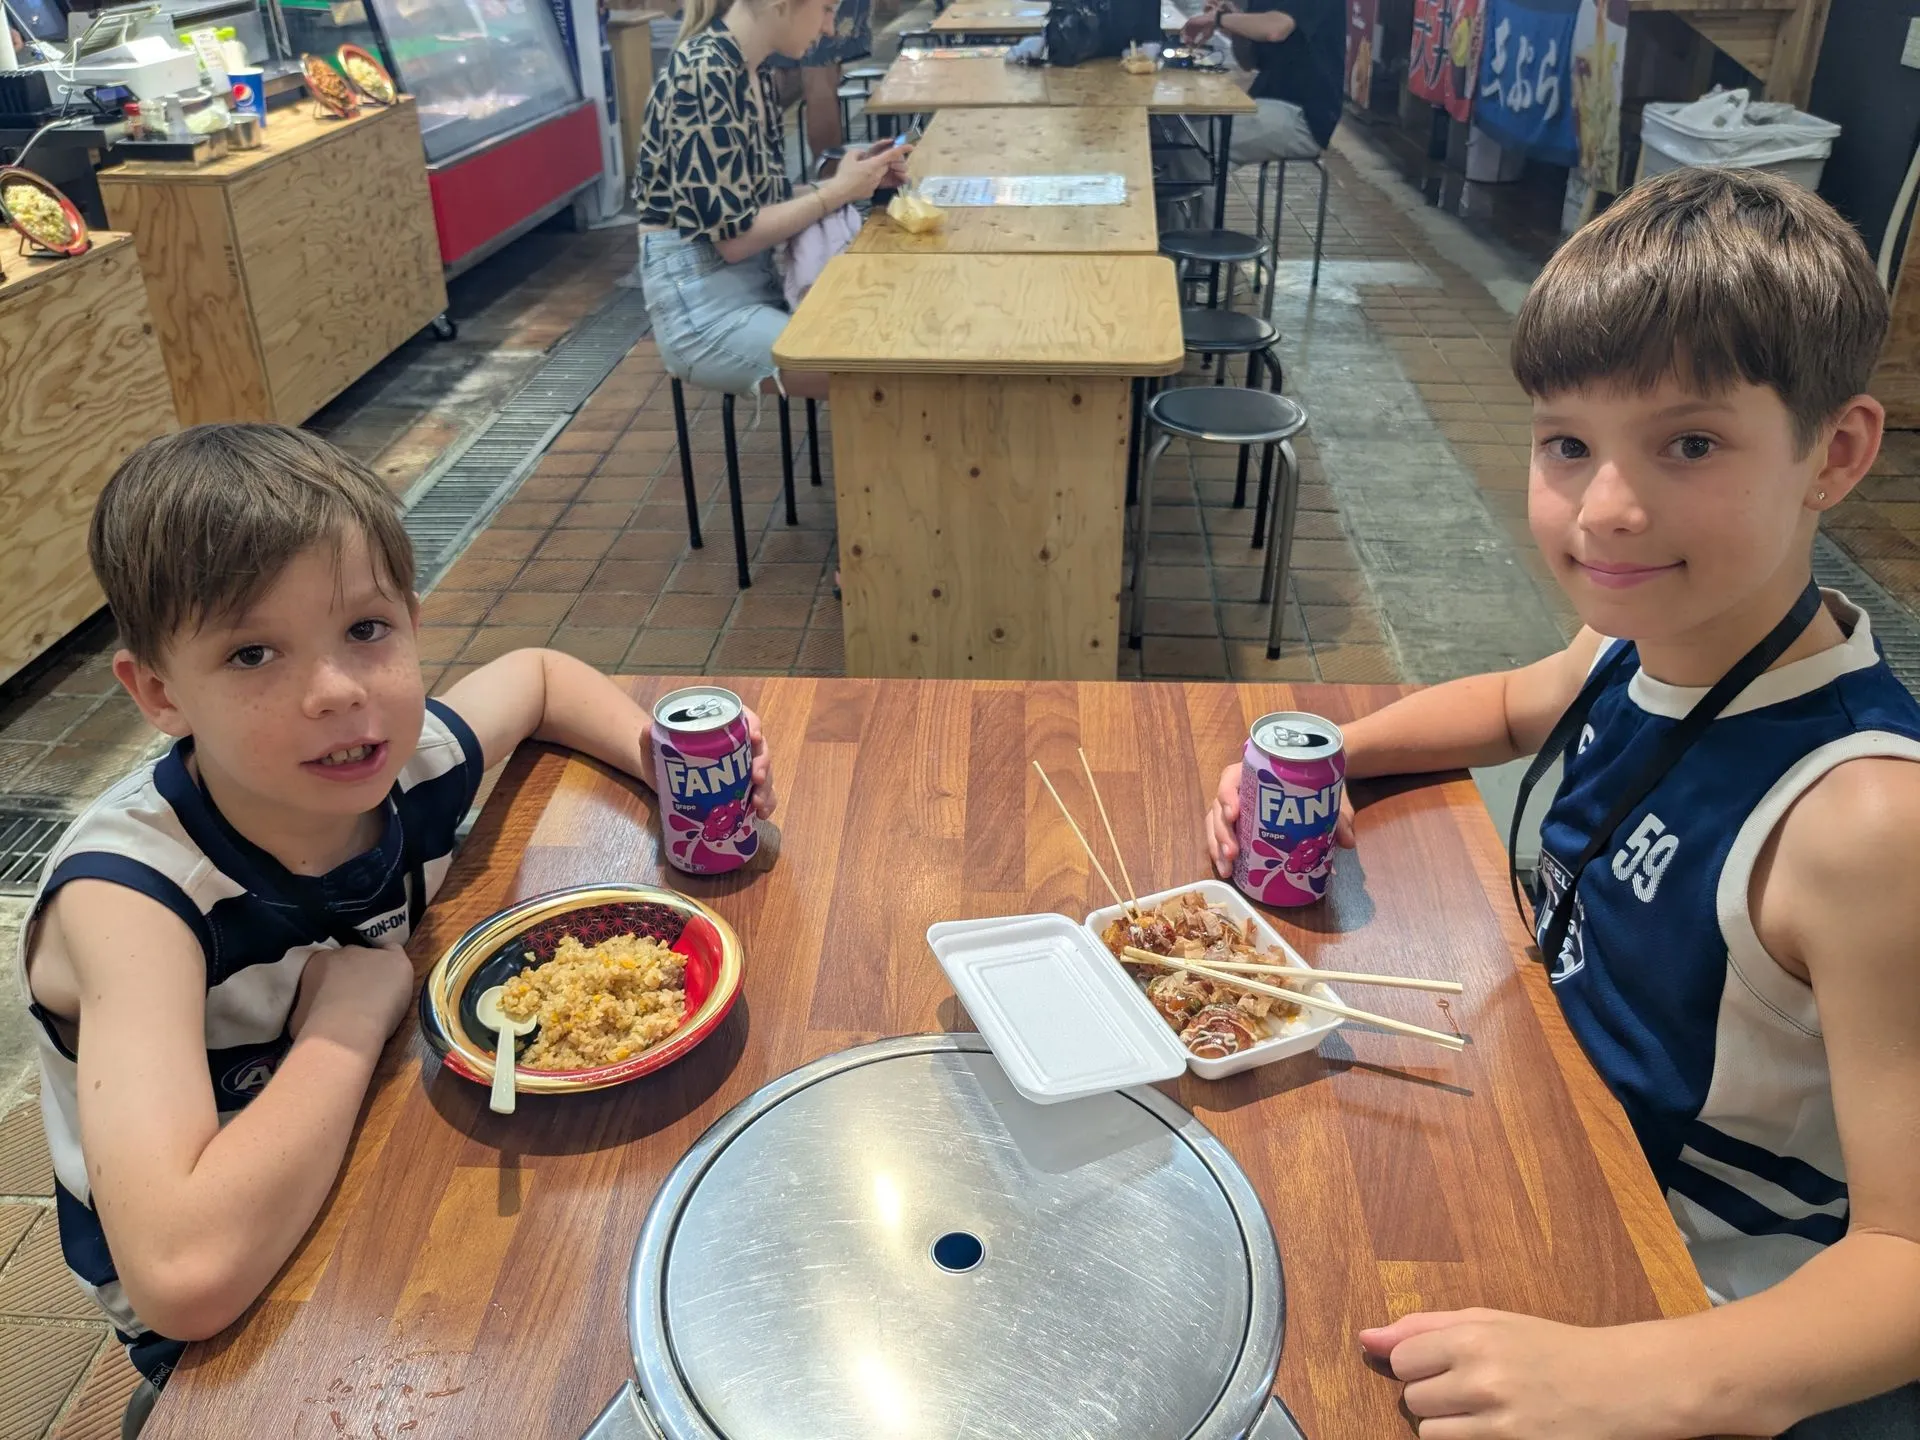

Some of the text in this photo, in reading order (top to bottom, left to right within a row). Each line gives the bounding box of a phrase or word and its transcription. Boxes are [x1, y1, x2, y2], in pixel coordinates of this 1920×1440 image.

[675, 803, 697, 811] grape
[1261, 830, 1285, 841] grape
[1611, 812, 1680, 903] 59
